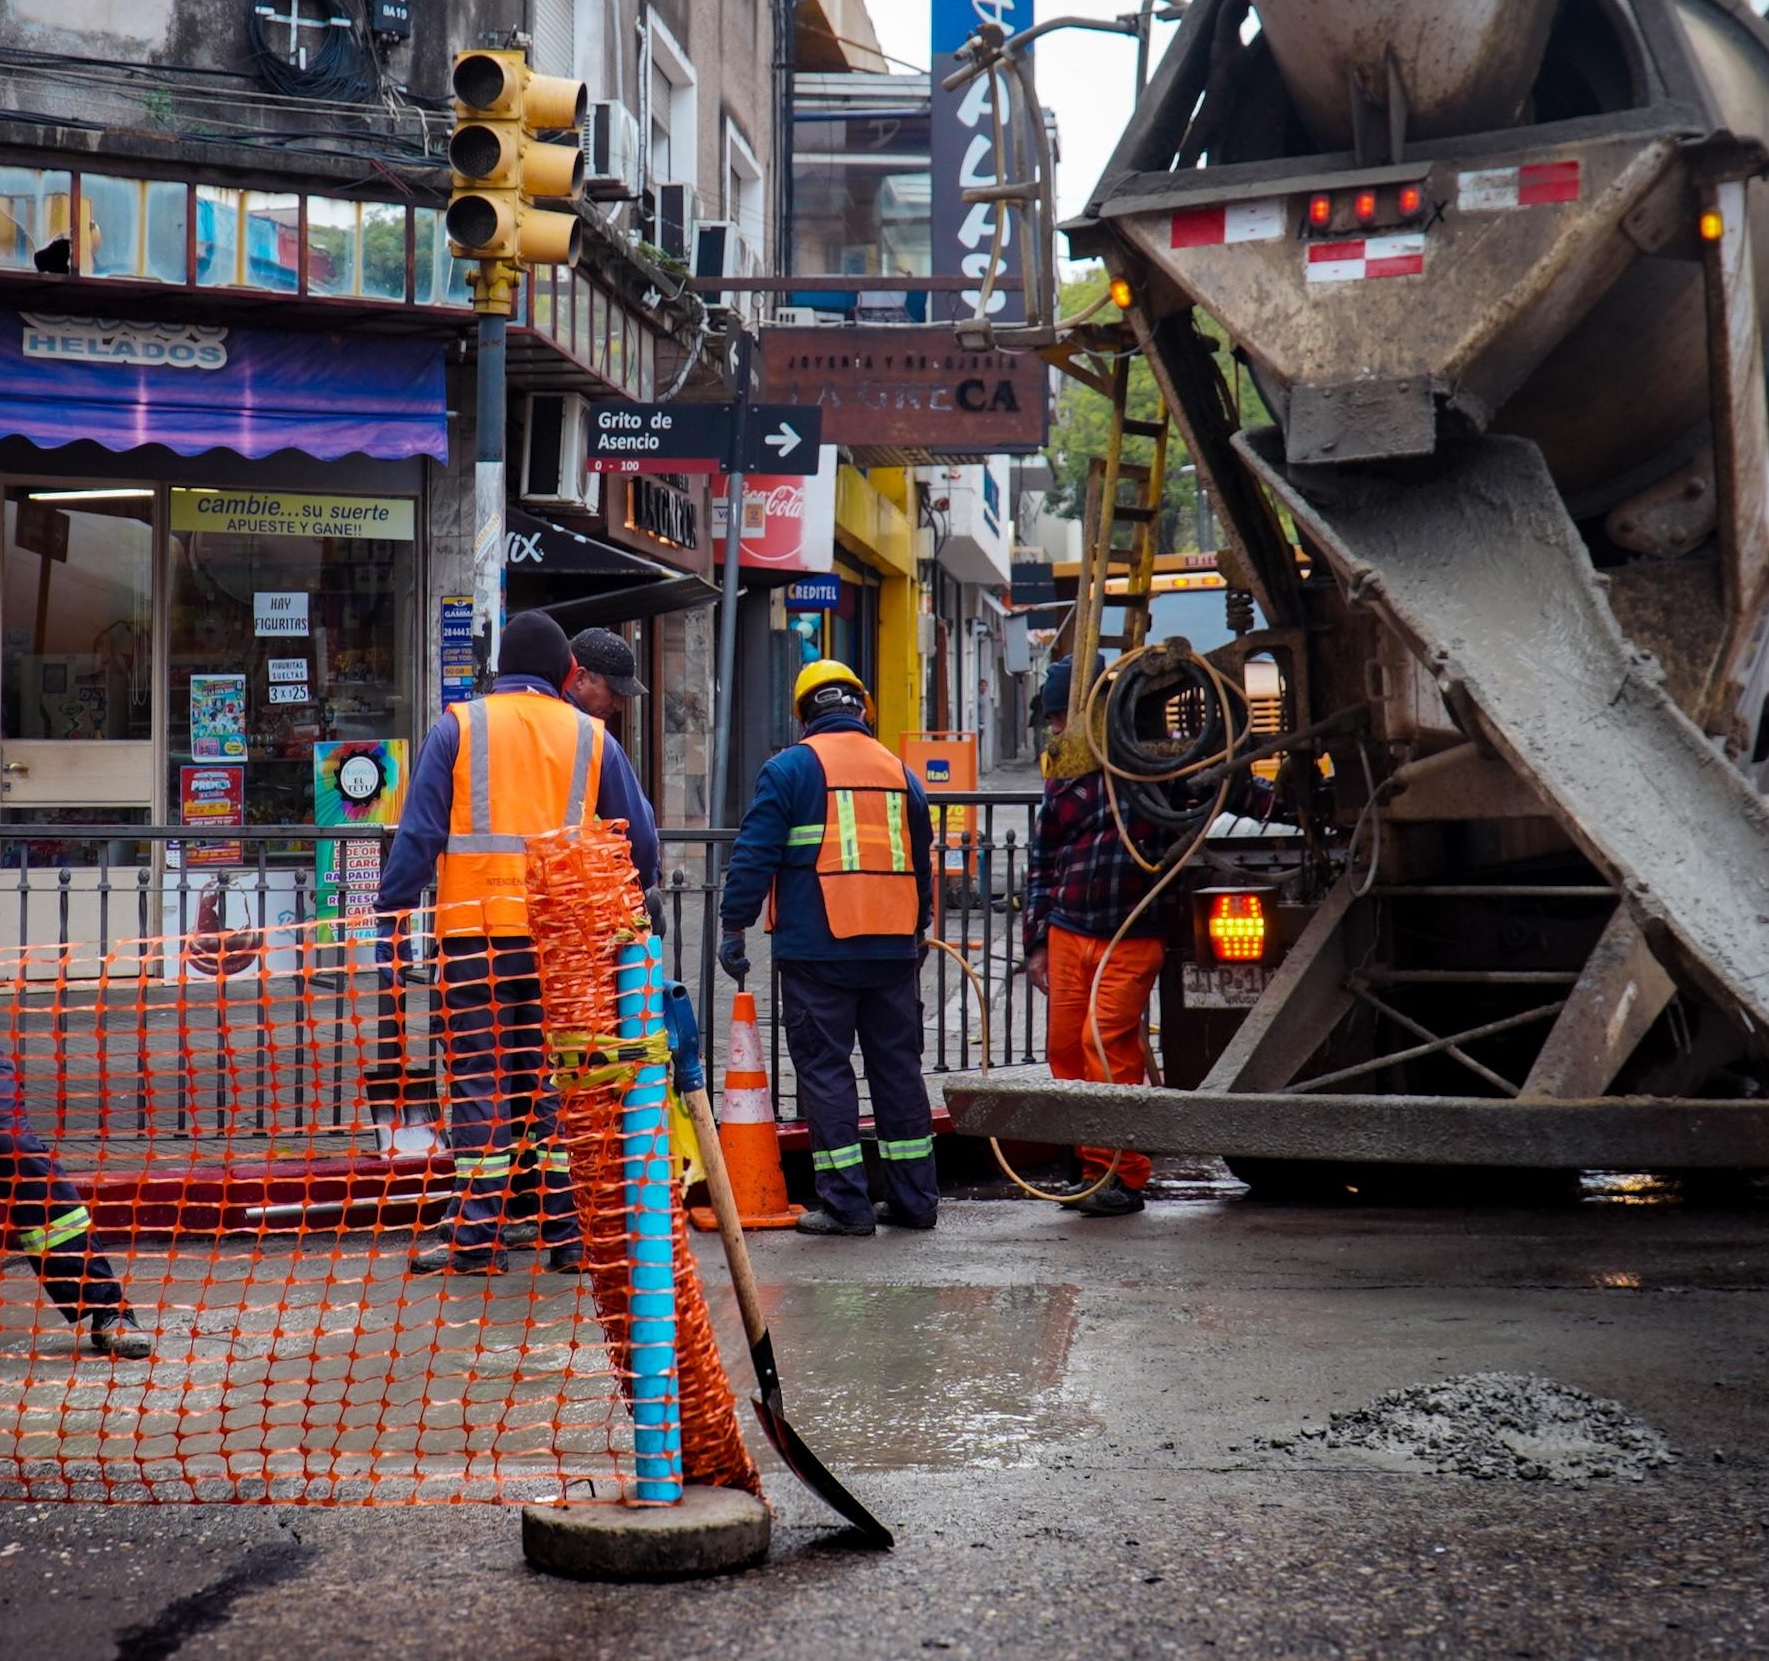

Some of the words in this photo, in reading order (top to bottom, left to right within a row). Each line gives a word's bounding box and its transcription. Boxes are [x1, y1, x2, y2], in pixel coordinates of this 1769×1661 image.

[29, 334, 221, 362] HELADOS
[598, 411, 642, 429] Grito
[650, 411, 673, 429] de
[597, 433, 660, 450] Asencio
[595, 460, 602, 471] 0
[620, 460, 640, 471] 100
[330, 504, 389, 521] suerte
[226, 518, 296, 533] APUESTE
[300, 521, 309, 534] Y
[312, 522, 362, 537] GANE!!
[787, 583, 837, 600] CREDITEL
[271, 597, 291, 610] HAY
[255, 618, 307, 631] FIGURITAS
[273, 672, 304, 680] SUELTAS
[271, 687, 278, 701] 3
